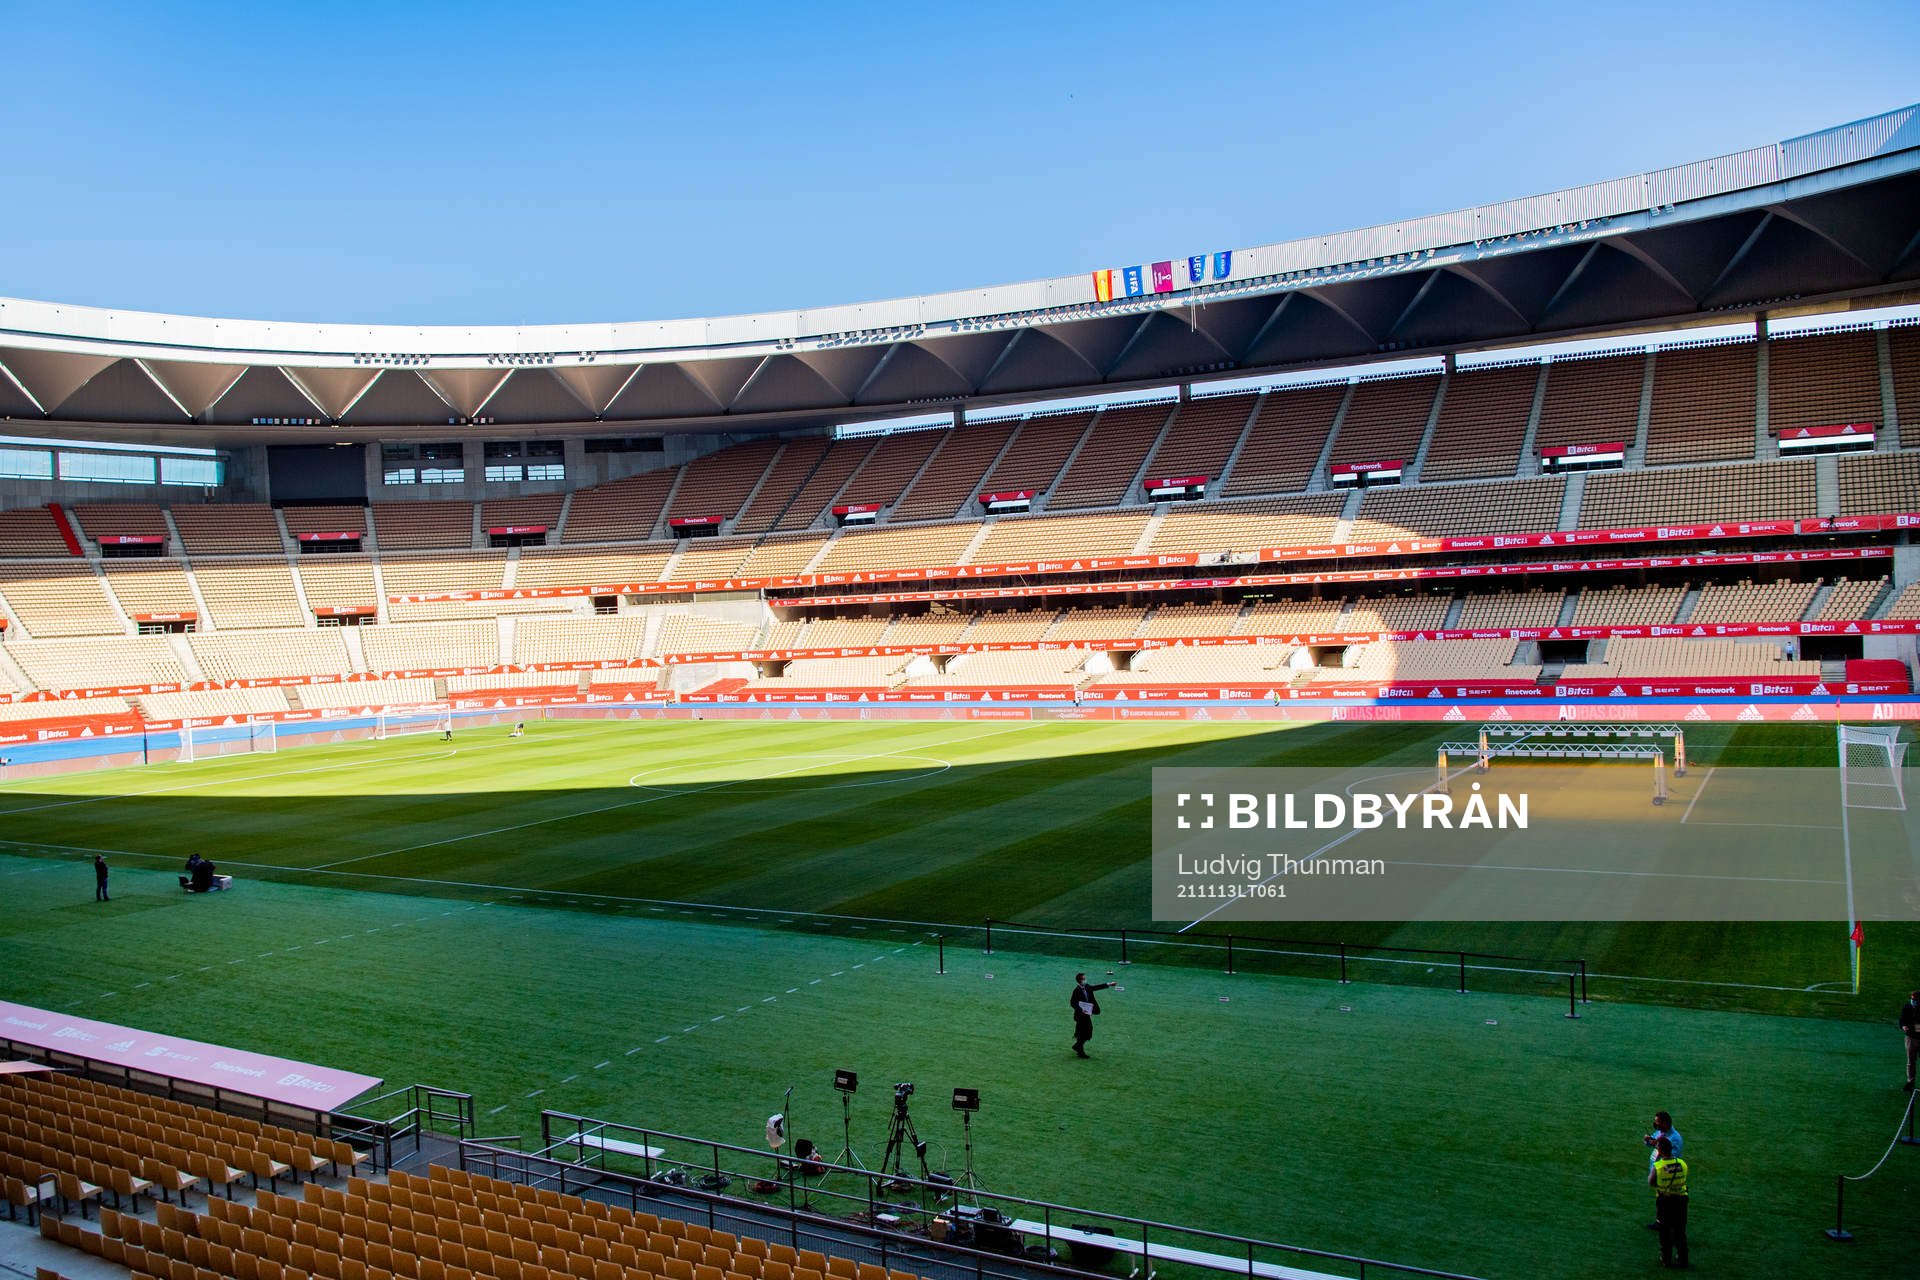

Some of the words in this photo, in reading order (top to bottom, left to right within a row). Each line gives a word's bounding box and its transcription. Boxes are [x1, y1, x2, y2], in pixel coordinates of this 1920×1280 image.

[1193, 256, 1201, 279] UEFA
[1128, 270, 1139, 294] FIFA
[1452, 540, 1483, 548] finetwork
[1610, 531, 1645, 539] finetwork
[1332, 707, 1401, 720] ADIDAS.COM
[1559, 705, 1638, 720] ADIDAS.COM
